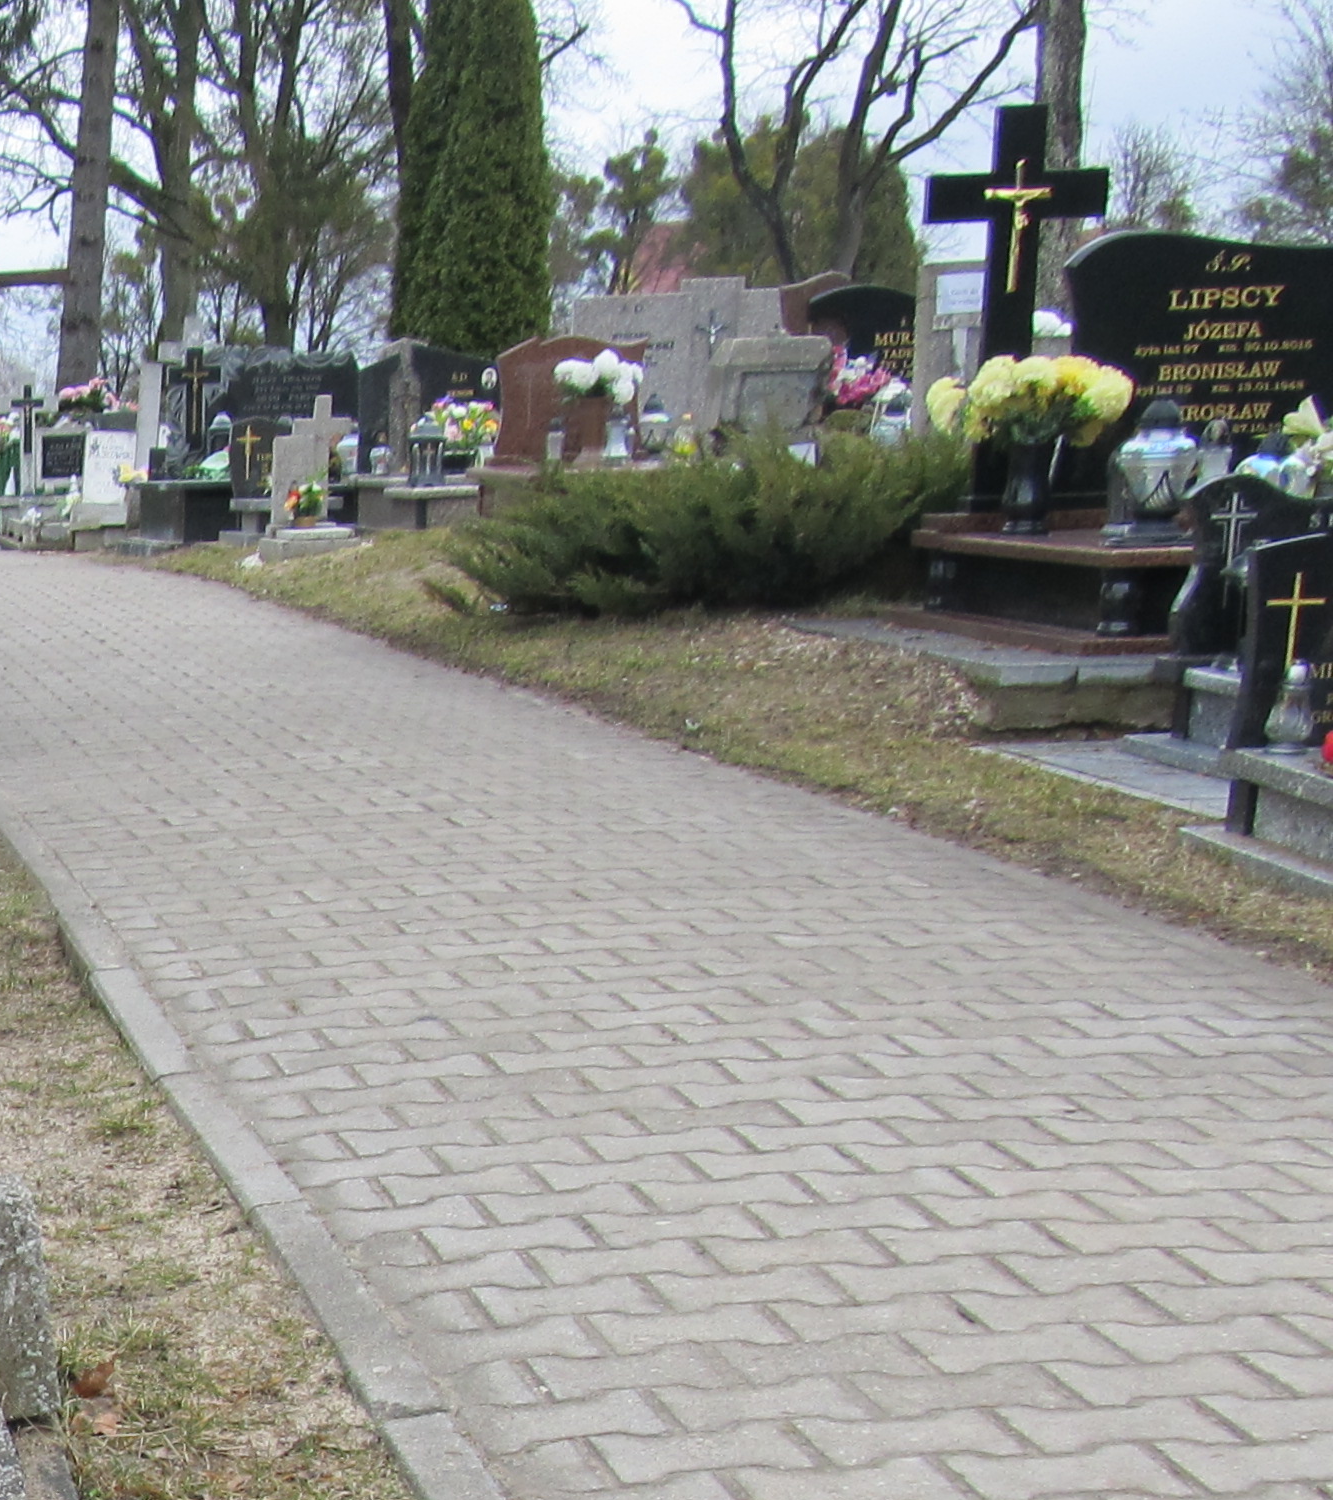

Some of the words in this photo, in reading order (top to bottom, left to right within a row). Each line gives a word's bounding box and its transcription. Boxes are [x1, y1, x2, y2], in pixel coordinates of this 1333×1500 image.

[1168, 285, 1284, 311] LIPSCY
[1184, 320, 1262, 340] JÓZEFA
[1159, 361, 1282, 382] BRONISŁAW
